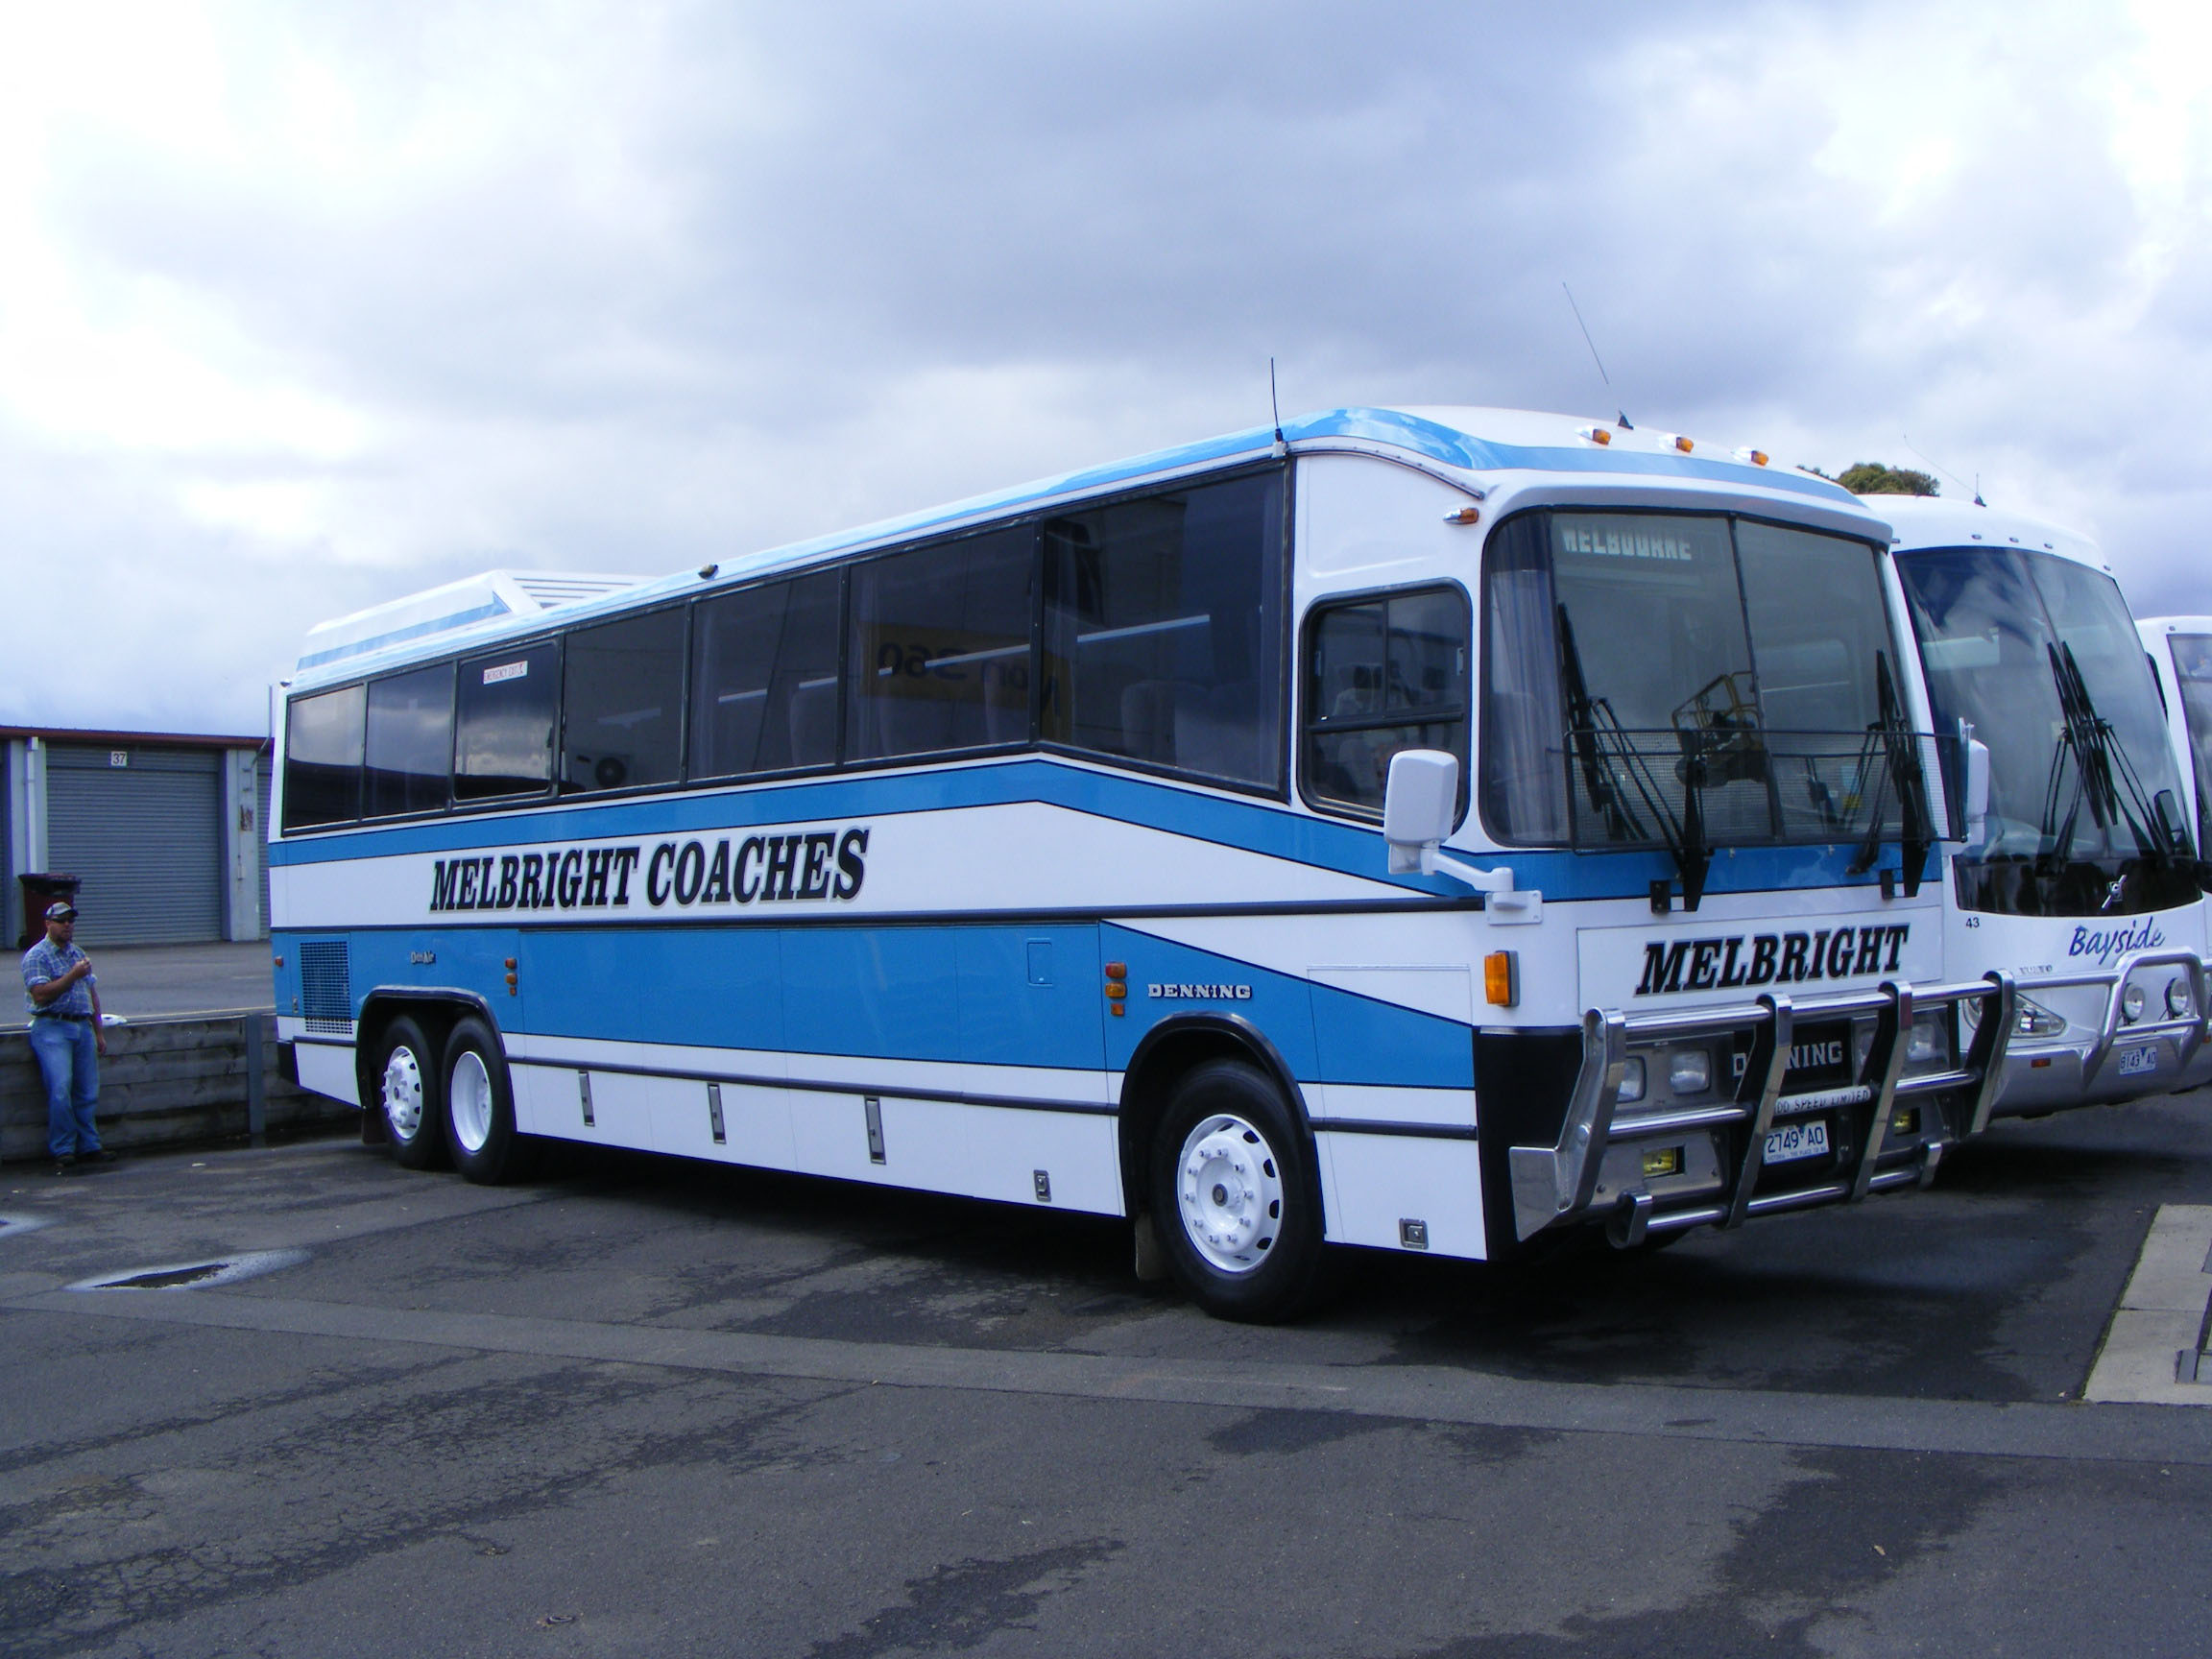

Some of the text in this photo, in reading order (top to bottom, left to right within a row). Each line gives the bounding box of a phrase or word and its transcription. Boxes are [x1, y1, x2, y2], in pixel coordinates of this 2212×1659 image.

[112, 753, 126, 765] 37
[429, 826, 871, 912] MELBRIGHT COACHES
[1965, 917, 1981, 928] 43
[2069, 916, 2165, 965] Bayside
[1633, 922, 1911, 998] MELBRIGHT
[1147, 983, 1252, 998] DENNING
[1733, 1041, 1842, 1077] DNING
[1793, 1096, 1826, 1112] SPEED
[1831, 1090, 1870, 1106] LIMITED
[1767, 1126, 1824, 1153] 2749 AO
